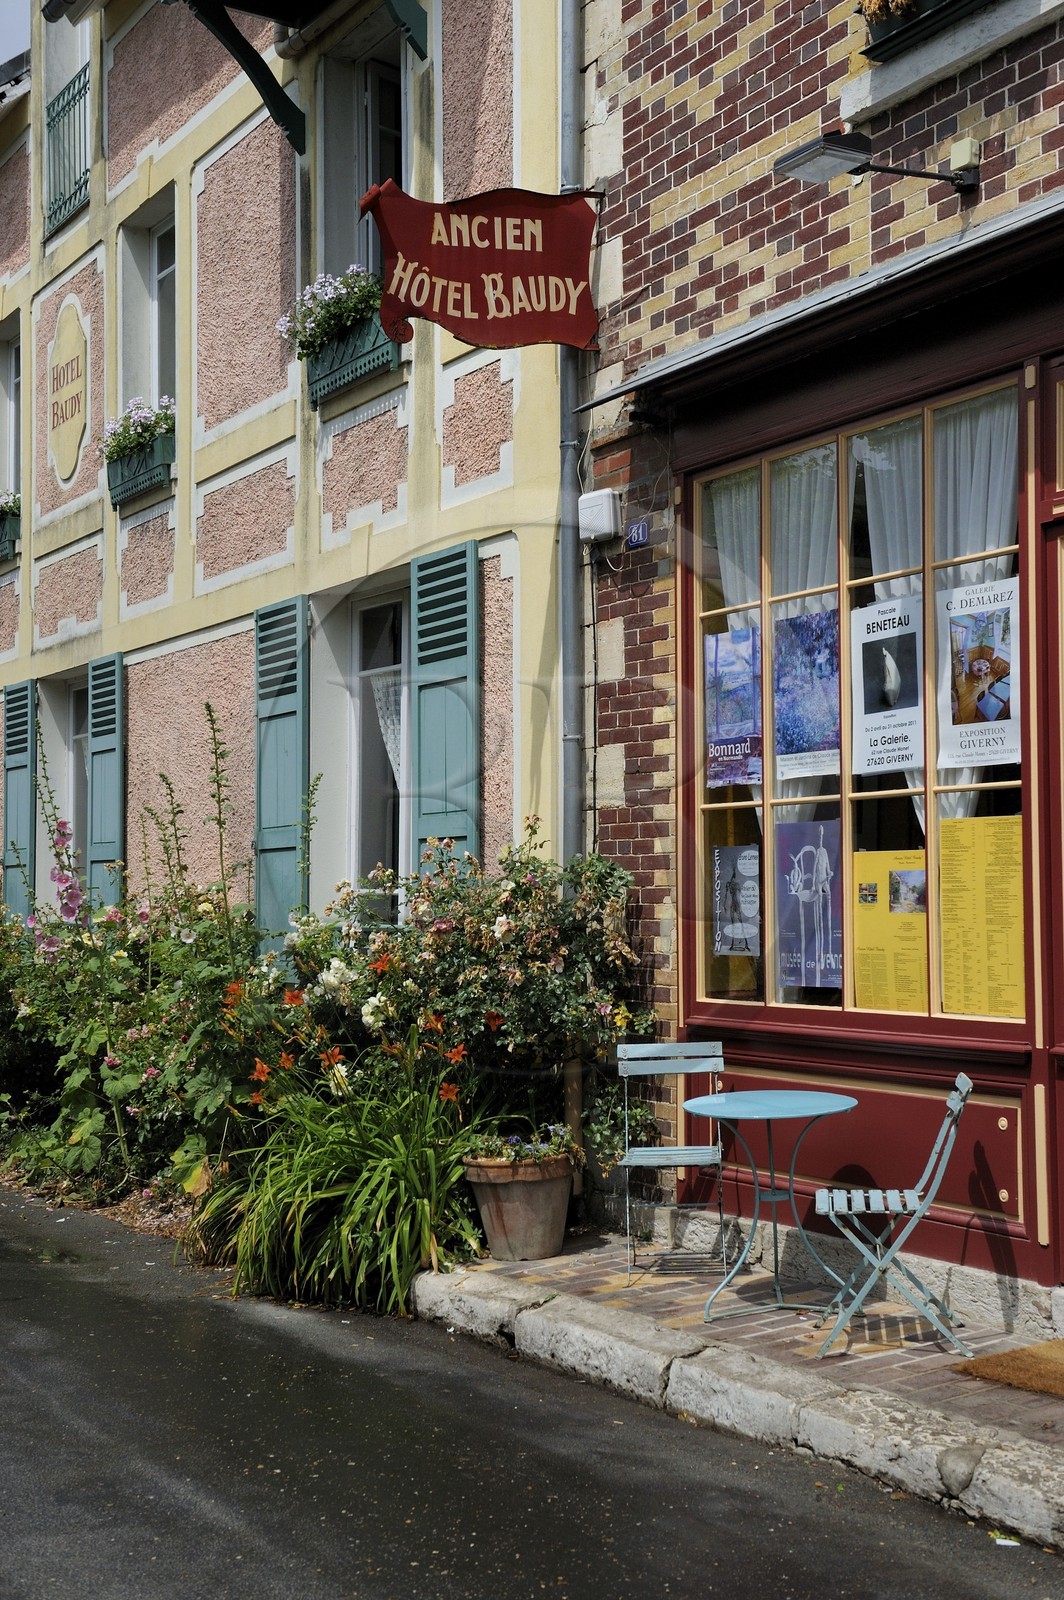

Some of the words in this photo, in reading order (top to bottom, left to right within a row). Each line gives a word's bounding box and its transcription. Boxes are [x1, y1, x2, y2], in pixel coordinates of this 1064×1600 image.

[431, 212, 543, 252] ANCIEN
[386, 251, 479, 320] HÔTEL
[480, 272, 588, 321] BAUDY
[52, 355, 82, 395] HOTEL
[52, 390, 83, 430] BAUDY
[945, 600, 956, 611] C.
[960, 590, 1014, 609] DEMAREZ
[965, 584, 996, 596] GALERIE
[866, 614, 910, 635] BENETEAU
[869, 737, 879, 748] La
[959, 726, 1007, 739] EXPOSITION
[959, 736, 1007, 750] GIVERNY
[708, 737, 751, 758] Bonnard
[866, 756, 885, 767] 27620
[886, 752, 914, 764] GIVERNY
[713, 849, 722, 952] EXPOSITION
[806, 960, 816, 969] de
